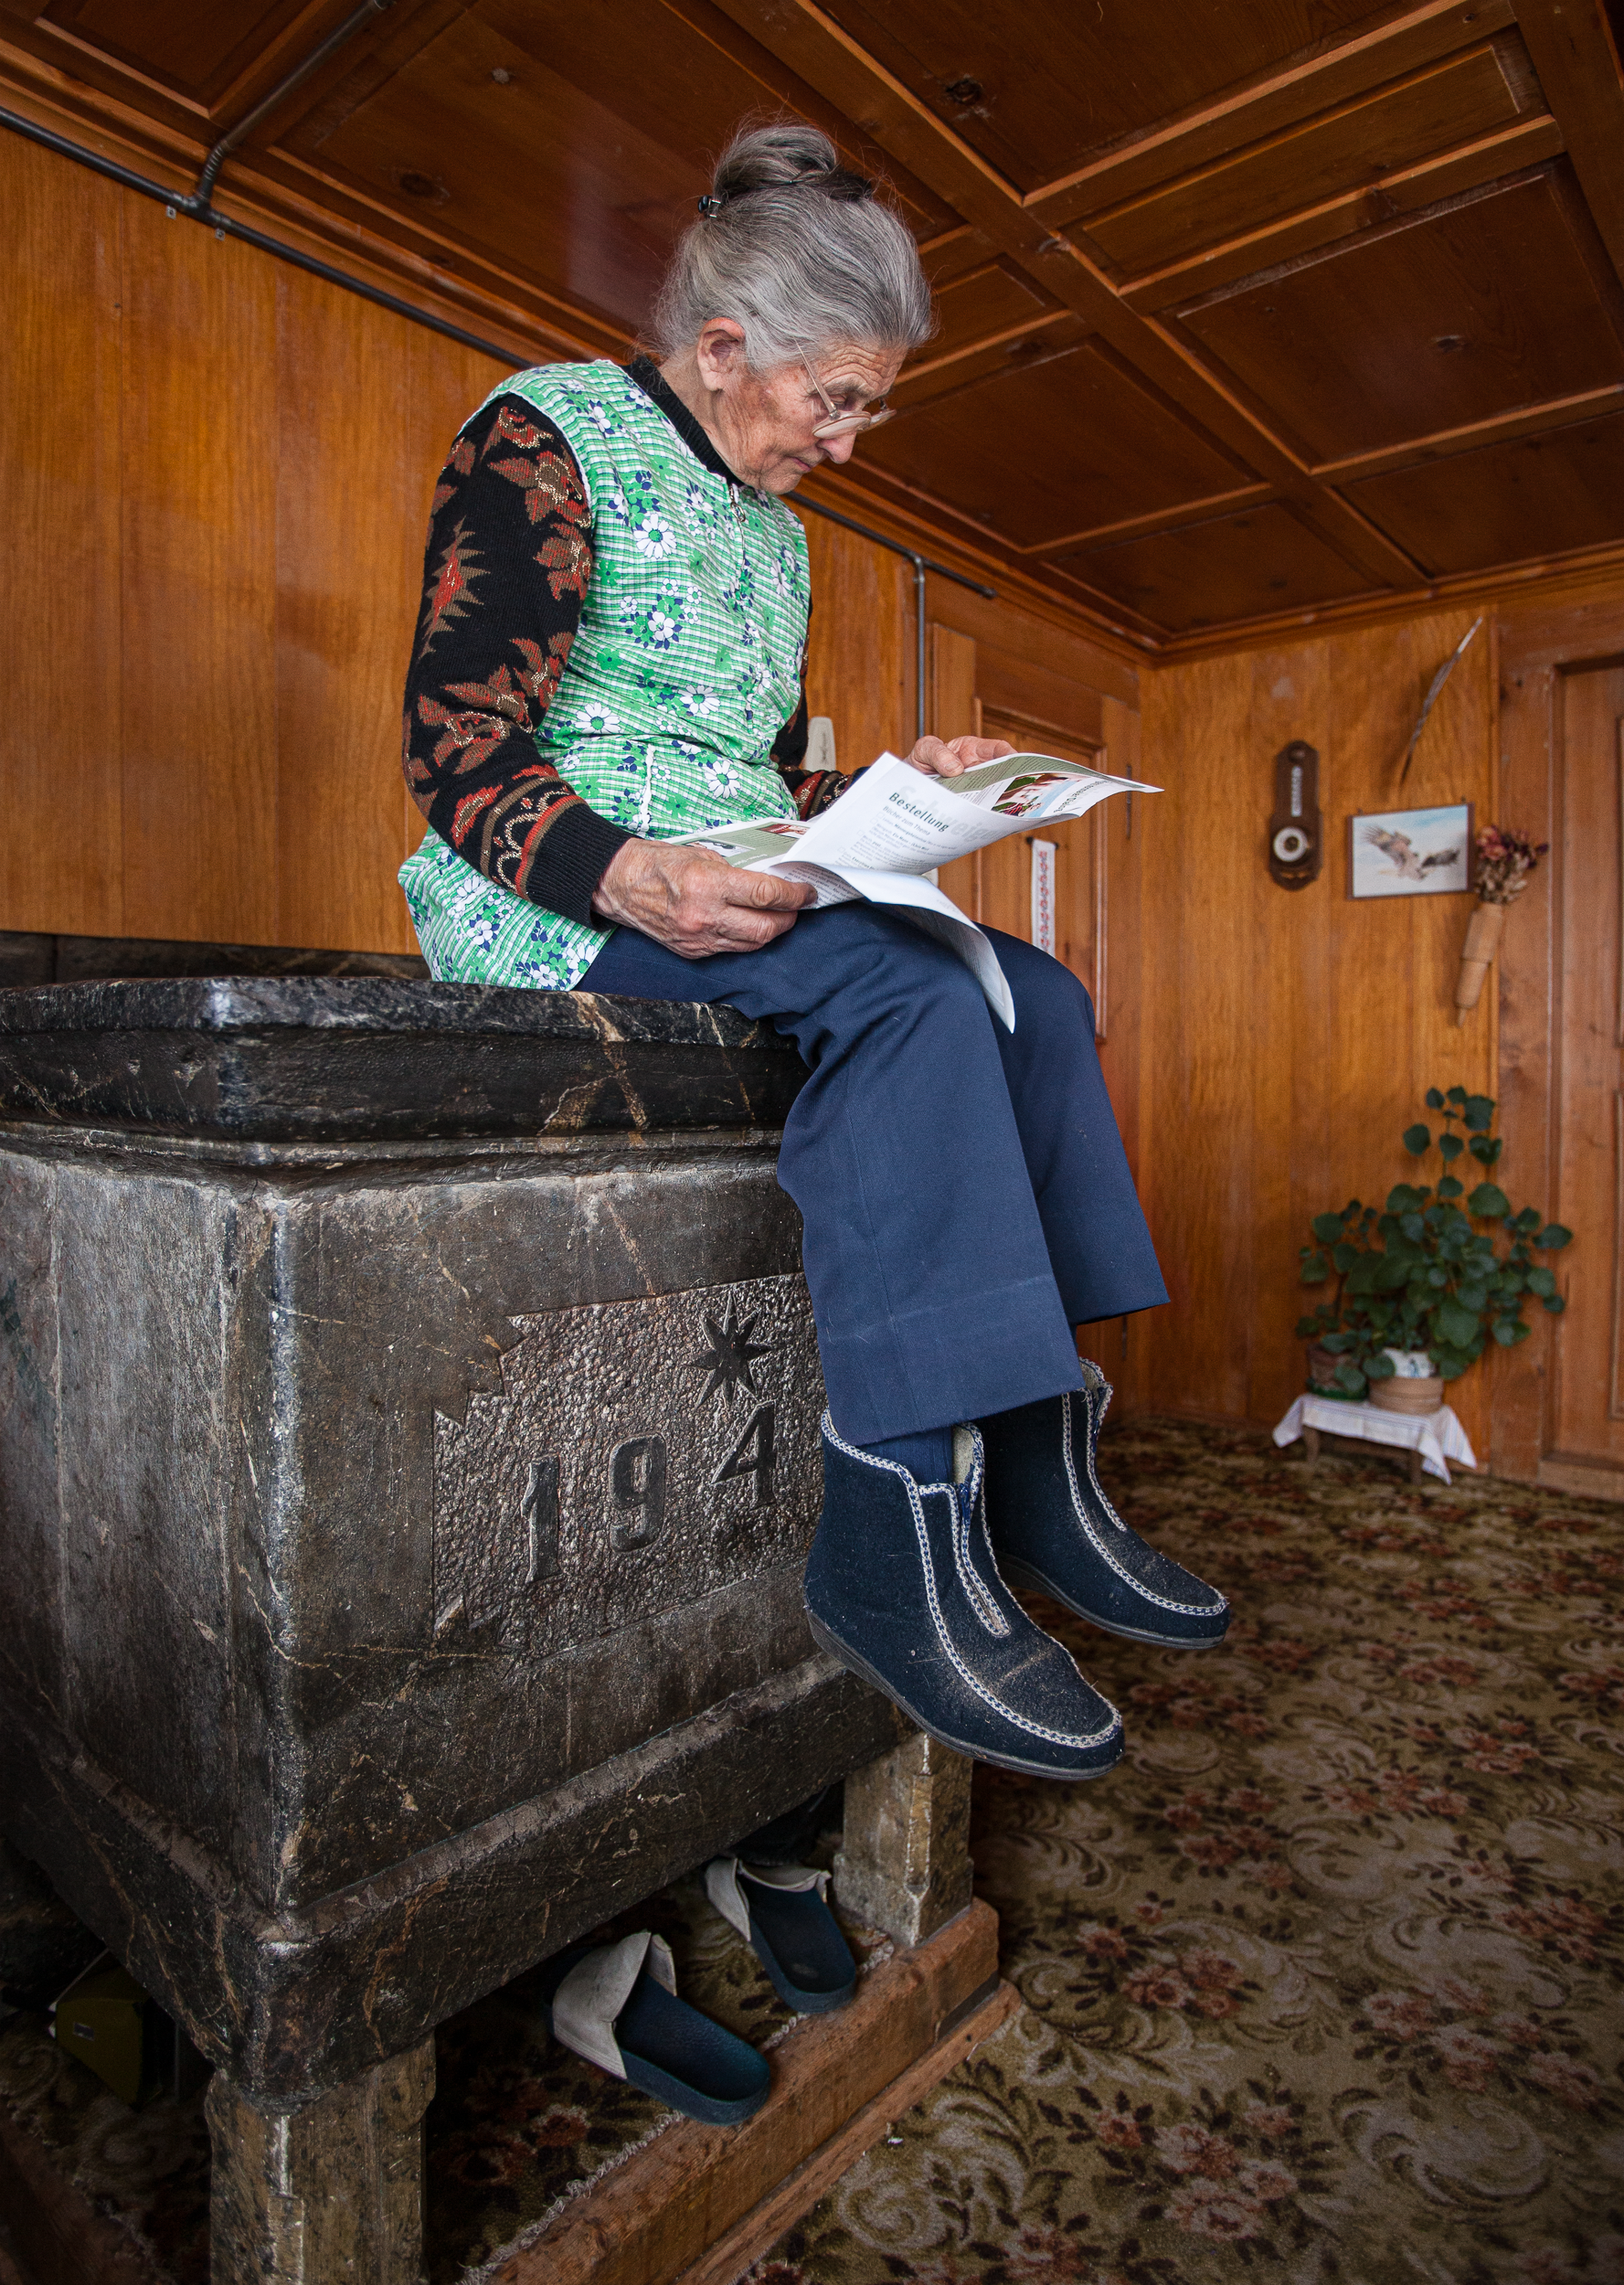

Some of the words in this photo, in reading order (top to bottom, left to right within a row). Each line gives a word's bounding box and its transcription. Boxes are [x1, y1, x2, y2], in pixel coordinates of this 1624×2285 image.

[883, 806, 902, 821] Bücher
[901, 817, 914, 827] zum
[914, 824, 930, 836] Thema
[888, 792, 950, 833] Bestellung
